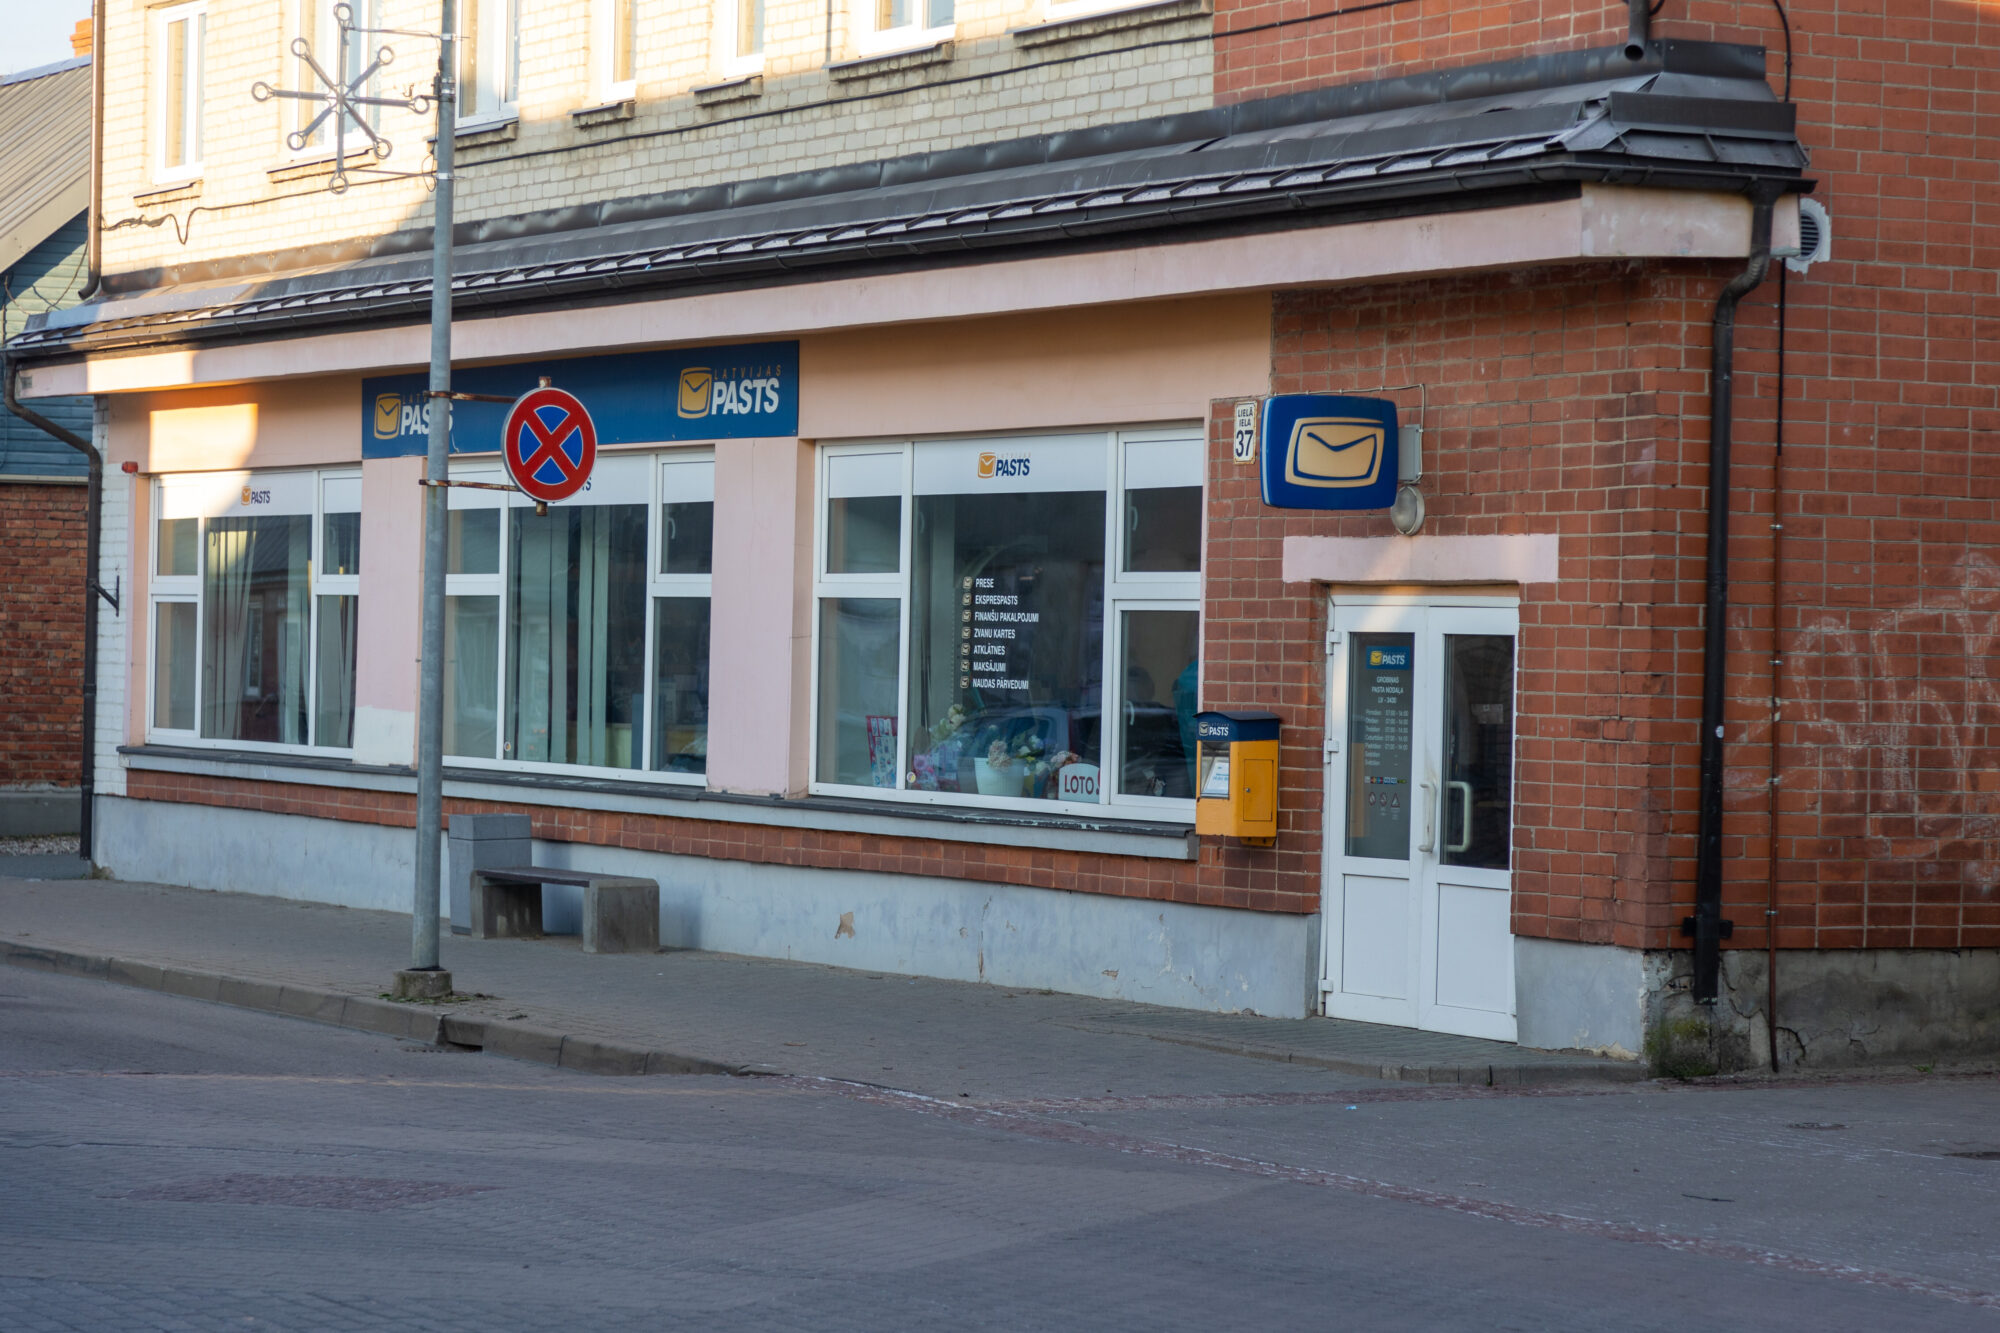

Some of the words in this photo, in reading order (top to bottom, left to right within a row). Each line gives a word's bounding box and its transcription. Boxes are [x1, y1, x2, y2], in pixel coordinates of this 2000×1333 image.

[714, 364, 781, 380] LATVIJAS
[711, 378, 780, 415] PASTS
[1239, 419, 1251, 427] IELA
[1235, 430, 1253, 457] 37
[995, 458, 1030, 477] PASTS
[250, 490, 271, 505] PASTS
[975, 578, 995, 589] PRESE
[975, 594, 1018, 605] EKSPRESPASTS
[974, 609, 999, 622] FINANŠU
[1000, 612, 1039, 623] PAKALPOJUMI
[994, 629, 1016, 639] KARTES
[973, 643, 1006, 655] ATKLĀTNES
[1382, 654, 1405, 665] PASTS
[973, 660, 1007, 673] MAKSĀJUMI
[973, 678, 996, 689] NAUDAS
[997, 676, 1029, 690] PĀRVEDUMI
[1209, 726, 1229, 736] PASTS
